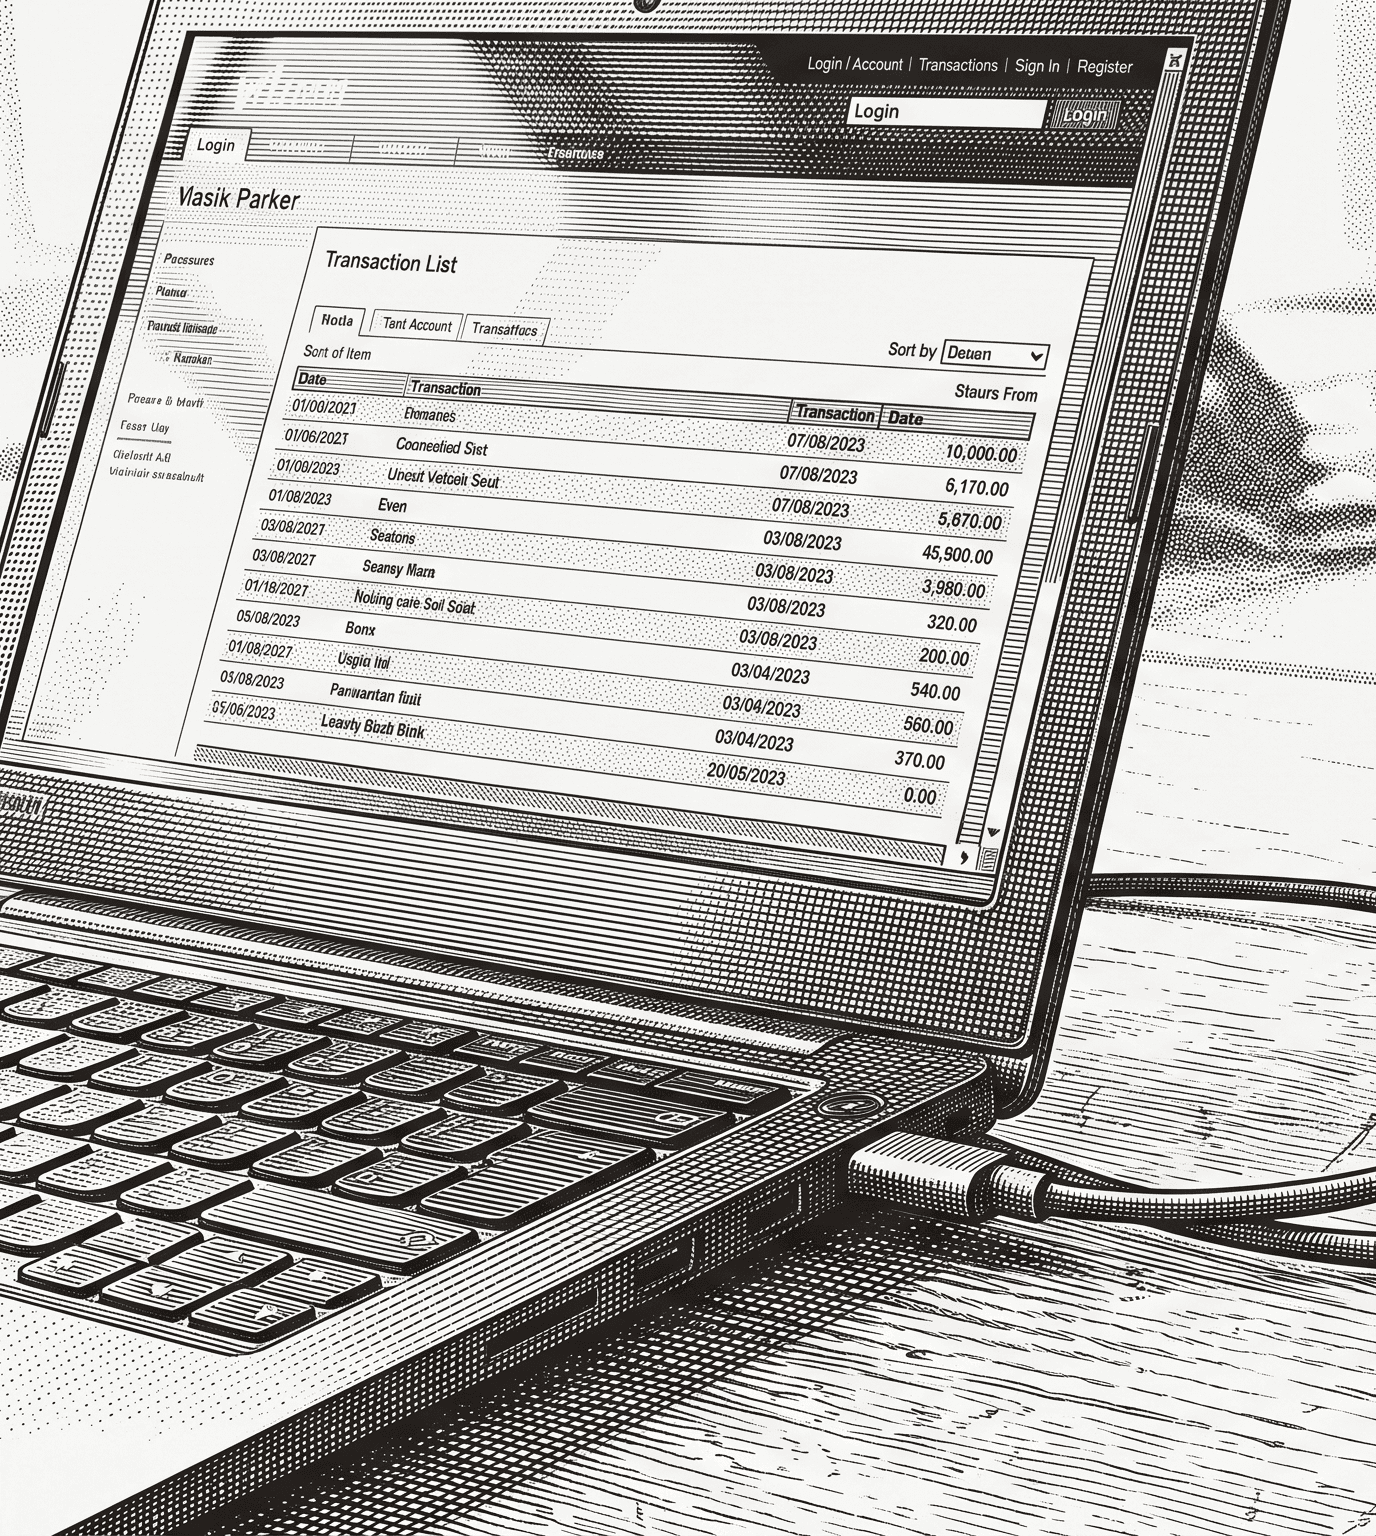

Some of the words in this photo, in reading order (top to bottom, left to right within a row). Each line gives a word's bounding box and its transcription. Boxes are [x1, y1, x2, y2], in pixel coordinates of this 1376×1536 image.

[808, 56, 842, 74] Login
[853, 57, 904, 73] Account
[919, 58, 998, 73] Transactions
[1015, 58, 1044, 75] Sign
[1048, 59, 1060, 74] In
[1077, 60, 1133, 77] Register
[855, 104, 898, 121] Login
[1063, 105, 1107, 124] Login
[197, 138, 234, 154] Login
[236, 188, 300, 210] Parker
[327, 251, 420, 271] Transaction
[426, 255, 457, 273] List
[408, 319, 453, 335] Account
[332, 347, 344, 358] of
[347, 347, 372, 361] Item
[889, 342, 916, 356] Sort
[920, 344, 937, 361] by
[299, 372, 326, 385] Date
[412, 380, 481, 396] Transaction
[1004, 387, 1037, 402] From
[797, 403, 874, 422] Transaction
[888, 410, 923, 426] Date
[788, 433, 865, 452] 07/08/2023
[947, 444, 1017, 462] 10,000.00
[780, 465, 857, 484] 07/08/2023
[946, 478, 1009, 496] 6,170.00
[379, 498, 406, 512] Even
[772, 498, 849, 517] 07/08/2023
[370, 529, 415, 544] Seatons
[363, 560, 403, 578] Seansy
[756, 563, 833, 584] 03/08/2023
[748, 596, 825, 617] 03/08/2023
[237, 610, 300, 627] 05/08/2023
[928, 615, 977, 632] 320.00
[346, 621, 375, 636] Bonx
[919, 648, 969, 666] 200.00
[732, 663, 810, 684] 03/04/2023
[911, 682, 960, 701] 540.00
[723, 696, 801, 718] 03/04/2023
[397, 723, 424, 738] Bink
[716, 729, 793, 752] 03/04/2023
[895, 751, 945, 770] 370.00
[707, 763, 785, 785] 20/05/2023
[905, 787, 936, 805] 0.00
